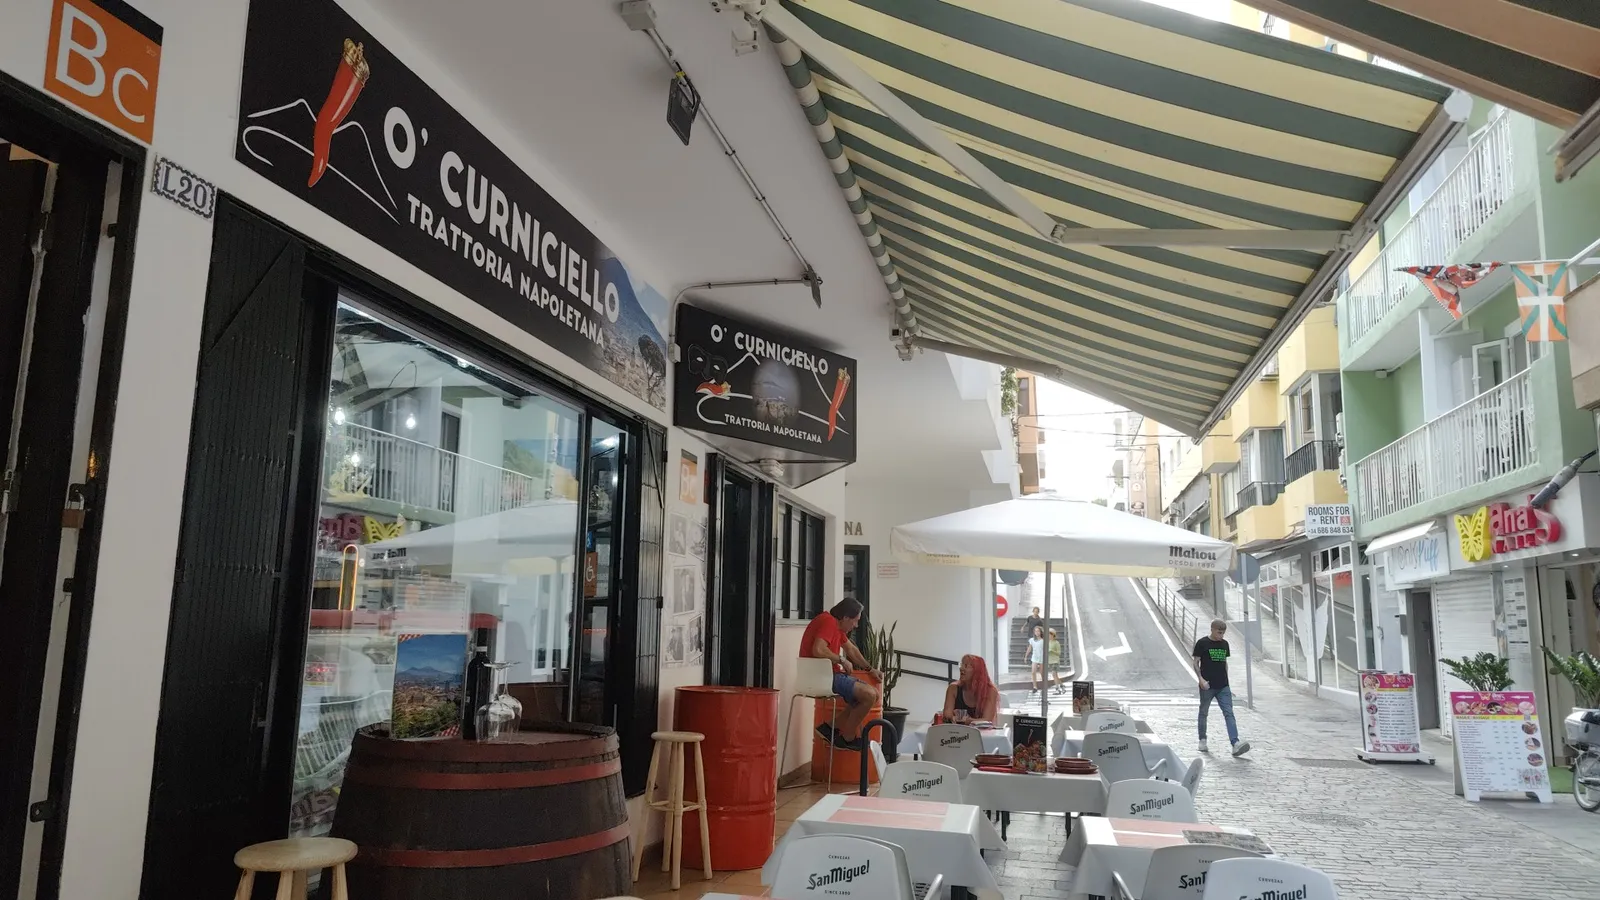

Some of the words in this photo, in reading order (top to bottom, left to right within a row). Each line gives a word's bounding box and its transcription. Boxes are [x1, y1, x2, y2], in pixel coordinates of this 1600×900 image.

[162, 165, 208, 209] L20
[440, 151, 619, 323] CURNICIELLO
[407, 193, 513, 288] TRATTORIA
[519, 272, 604, 348] NAPOLETANA
[734, 332, 829, 375] CURNICIELLO
[724, 413, 771, 432] TRATTORIA
[773, 425, 822, 444] NAPOLETANA
[1308, 506, 1334, 515] ROOMS
[1335, 506, 1350, 515] FOR
[1320, 515, 1338, 525] RENT
[1169, 545, 1217, 560] Mahou
[1258, 876, 1284, 884] CERVEZAS
